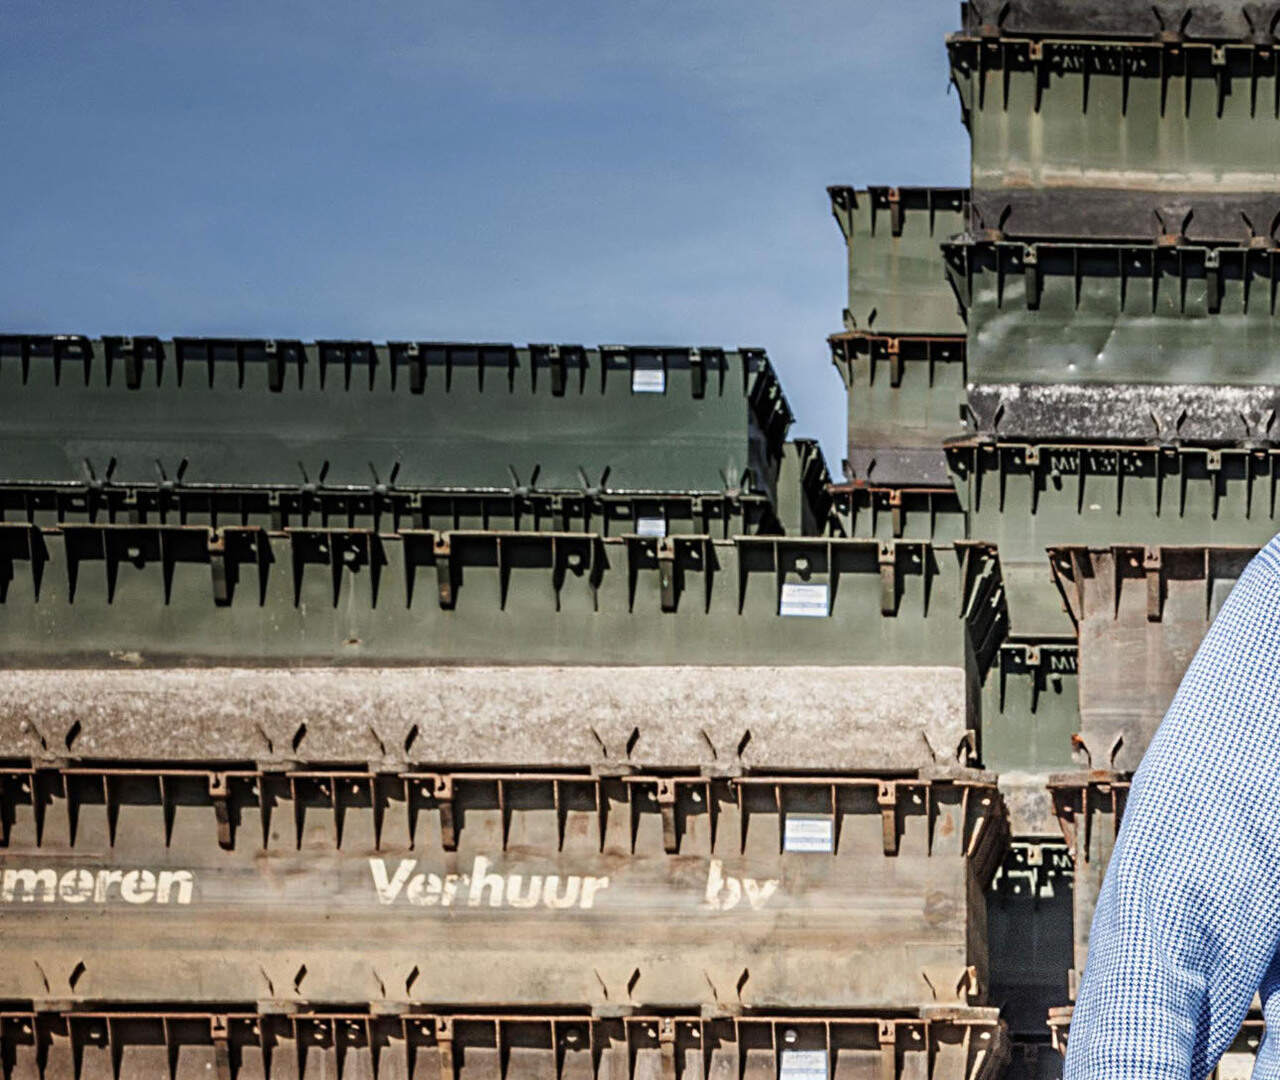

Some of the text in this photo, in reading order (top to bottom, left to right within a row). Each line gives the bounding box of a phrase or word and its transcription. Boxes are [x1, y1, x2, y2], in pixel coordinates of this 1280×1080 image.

[1, 856, 780, 911] meren Verhuur bv
